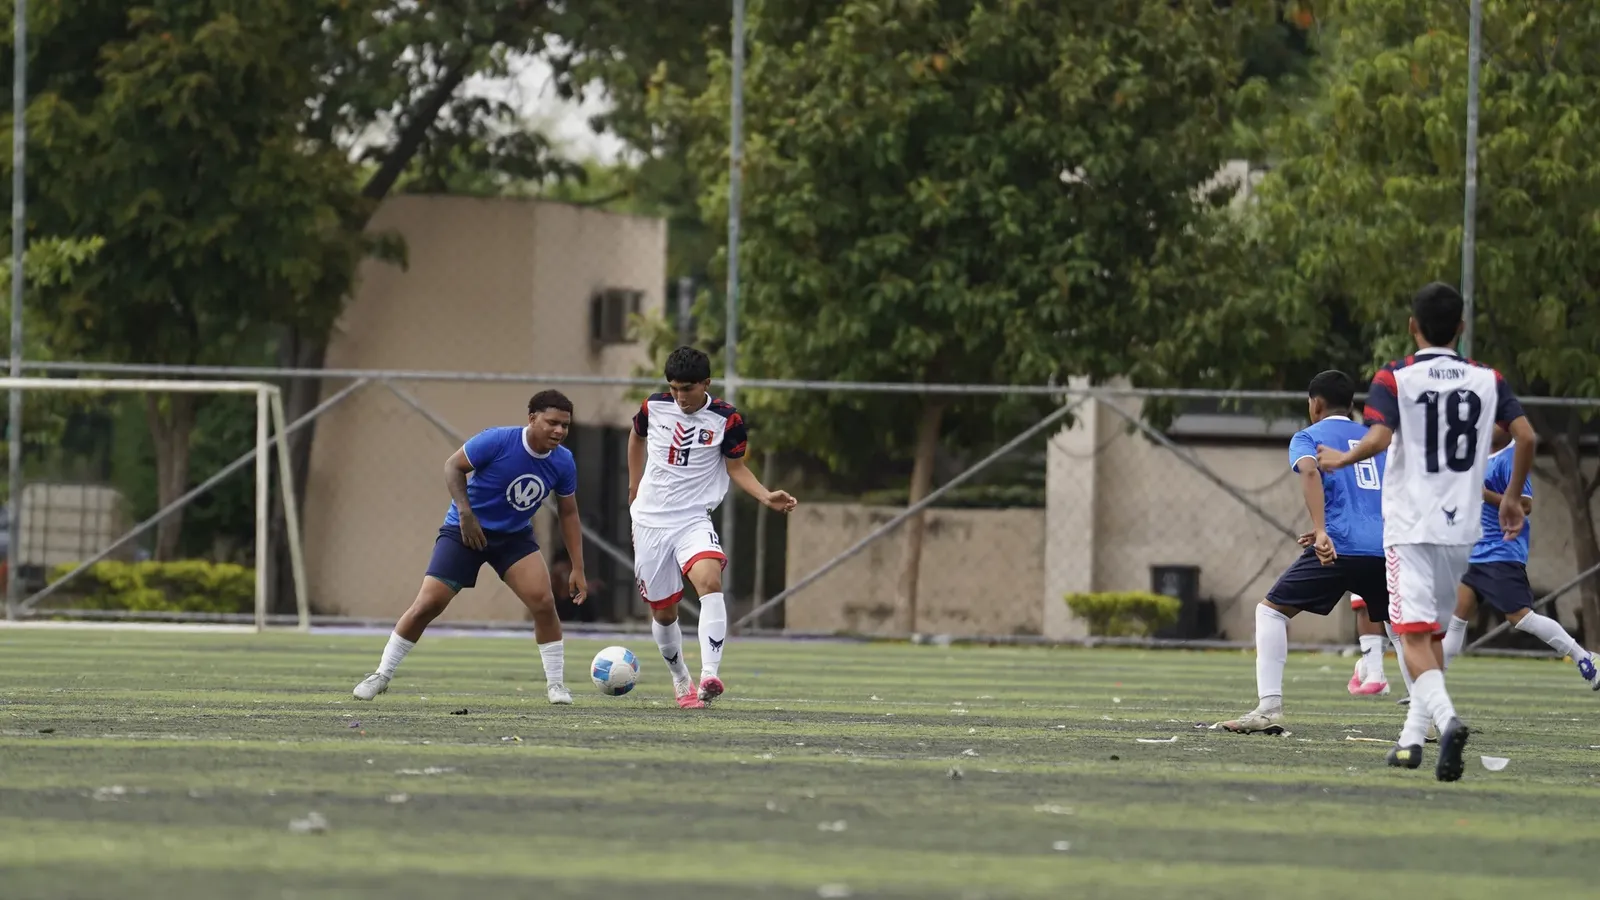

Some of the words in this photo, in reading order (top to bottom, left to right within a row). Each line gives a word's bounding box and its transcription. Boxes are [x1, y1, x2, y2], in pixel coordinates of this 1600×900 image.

[1428, 367, 1466, 380] ANTONY
[1415, 389, 1481, 473] 18
[672, 449, 686, 465] 15
